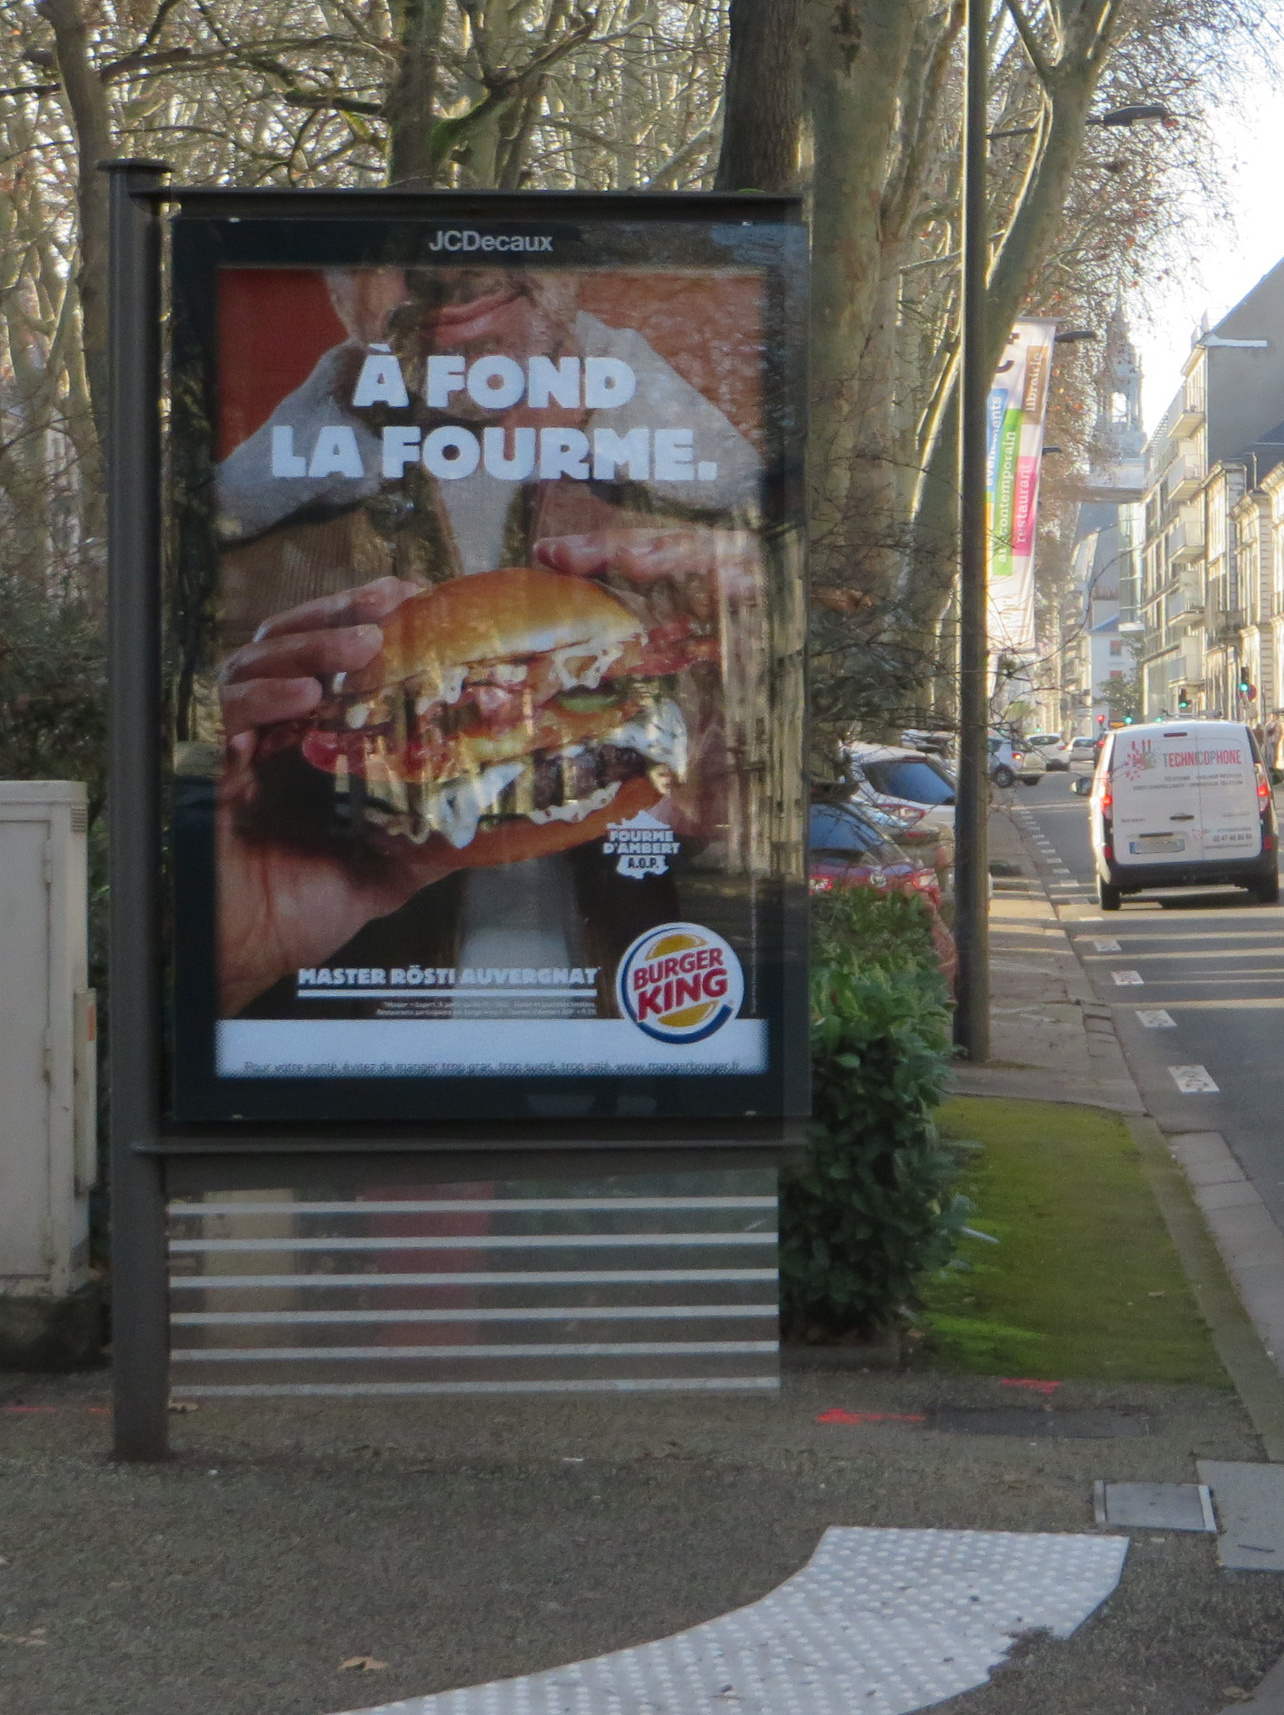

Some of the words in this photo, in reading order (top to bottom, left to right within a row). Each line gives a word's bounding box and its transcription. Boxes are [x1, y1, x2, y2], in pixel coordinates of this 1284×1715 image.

[429, 230, 554, 252] JCDecaux
[352, 343, 410, 408] À
[426, 354, 637, 409] FOND
[1025, 352, 1043, 412] librairie
[271, 425, 365, 479] LA
[381, 425, 718, 482] FOURME.
[999, 431, 1017, 537] contemporain
[1016, 463, 1032, 543] restaurant
[1162, 750, 1243, 768] TECHNICOPHONE
[603, 842, 682, 854] D'AMBERT
[609, 830, 675, 842] FOURME
[627, 856, 660, 869] A.O.P.
[298, 967, 387, 985] MASTER
[390, 964, 456, 985] RÖSTI
[633, 948, 725, 992] BURGER
[637, 967, 729, 1022] KING
